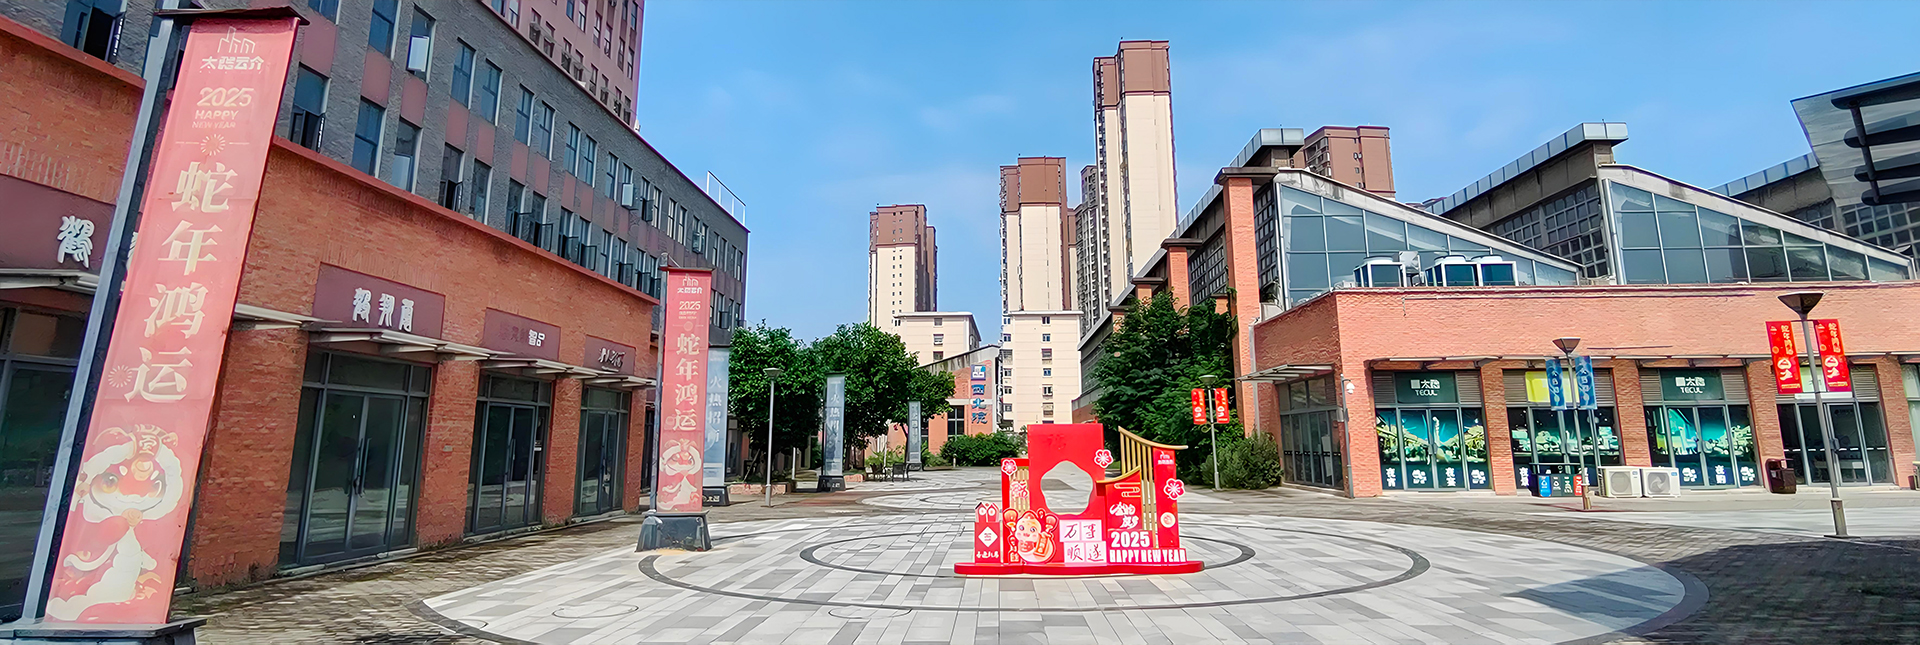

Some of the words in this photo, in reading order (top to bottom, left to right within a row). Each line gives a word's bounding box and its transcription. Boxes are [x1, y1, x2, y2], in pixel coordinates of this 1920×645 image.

[197, 87, 255, 107] 2025
[195, 110, 239, 120] HAPPY
[192, 121, 214, 129] NEW
[215, 121, 237, 129] YEAR
[123, 161, 239, 404] 蛇年鸿运
[679, 300, 701, 310] 2025
[672, 333, 701, 431] 蛇年鸿运
[1063, 523, 1098, 540] 万事
[1110, 531, 1151, 548] 2025
[1066, 543, 1105, 561] 顺遂
[1109, 549, 1140, 563] HAPPY
[1140, 549, 1161, 563] NEW
[1161, 549, 1187, 563] YEAR
